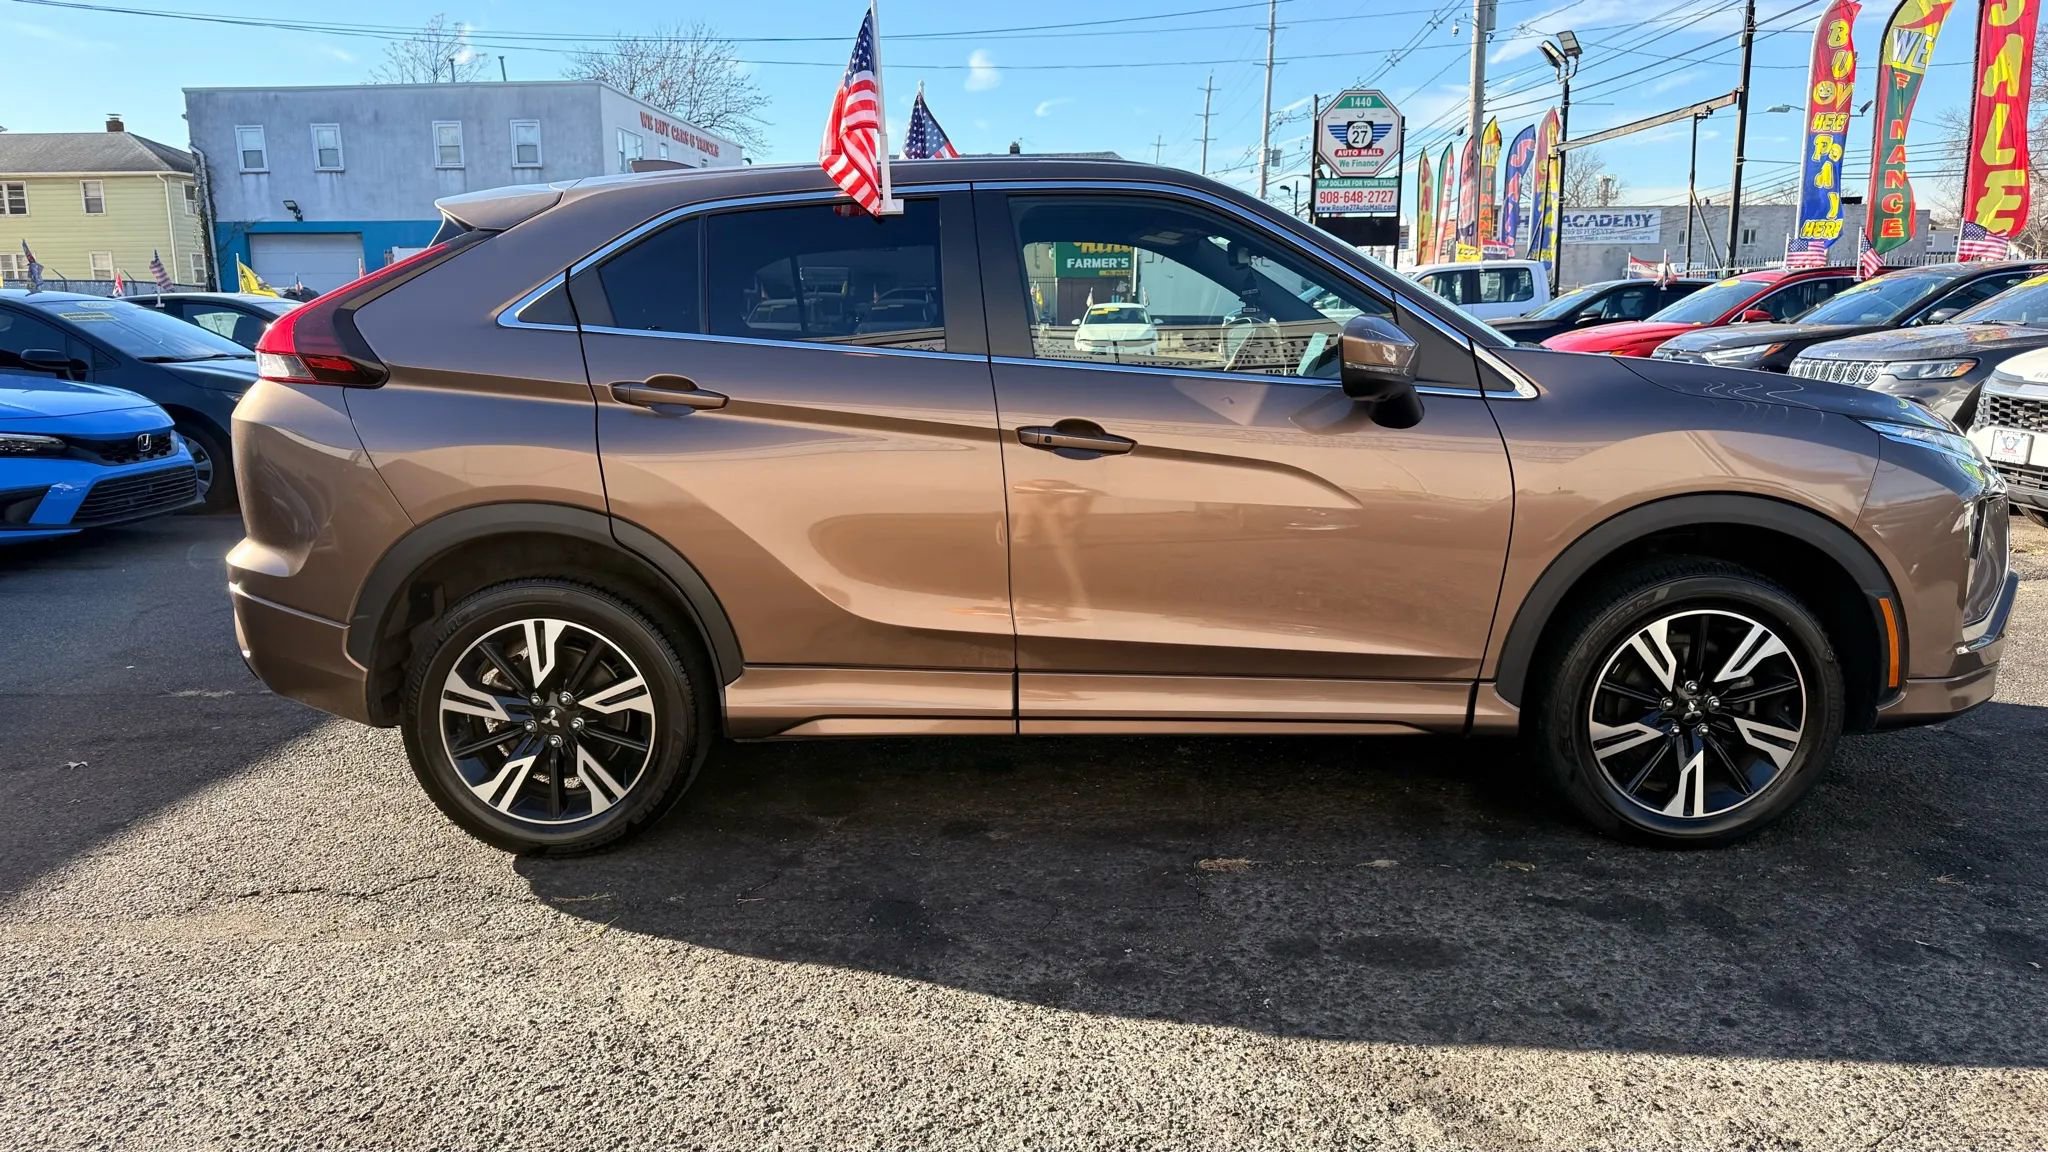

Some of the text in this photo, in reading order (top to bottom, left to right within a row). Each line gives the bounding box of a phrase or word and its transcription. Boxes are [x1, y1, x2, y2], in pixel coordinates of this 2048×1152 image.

[1892, 28, 1936, 70] WE
[1350, 96, 1372, 107] 1440
[655, 118, 670, 138] BUY
[671, 125, 689, 146] CARS
[1352, 130, 1368, 144] 27
[1337, 148, 1382, 157] AUTO MALL
[1339, 159, 1380, 168] We Finance
[1319, 190, 1394, 204] 908-648-2727
[1066, 257, 1129, 269] FARMER'S
